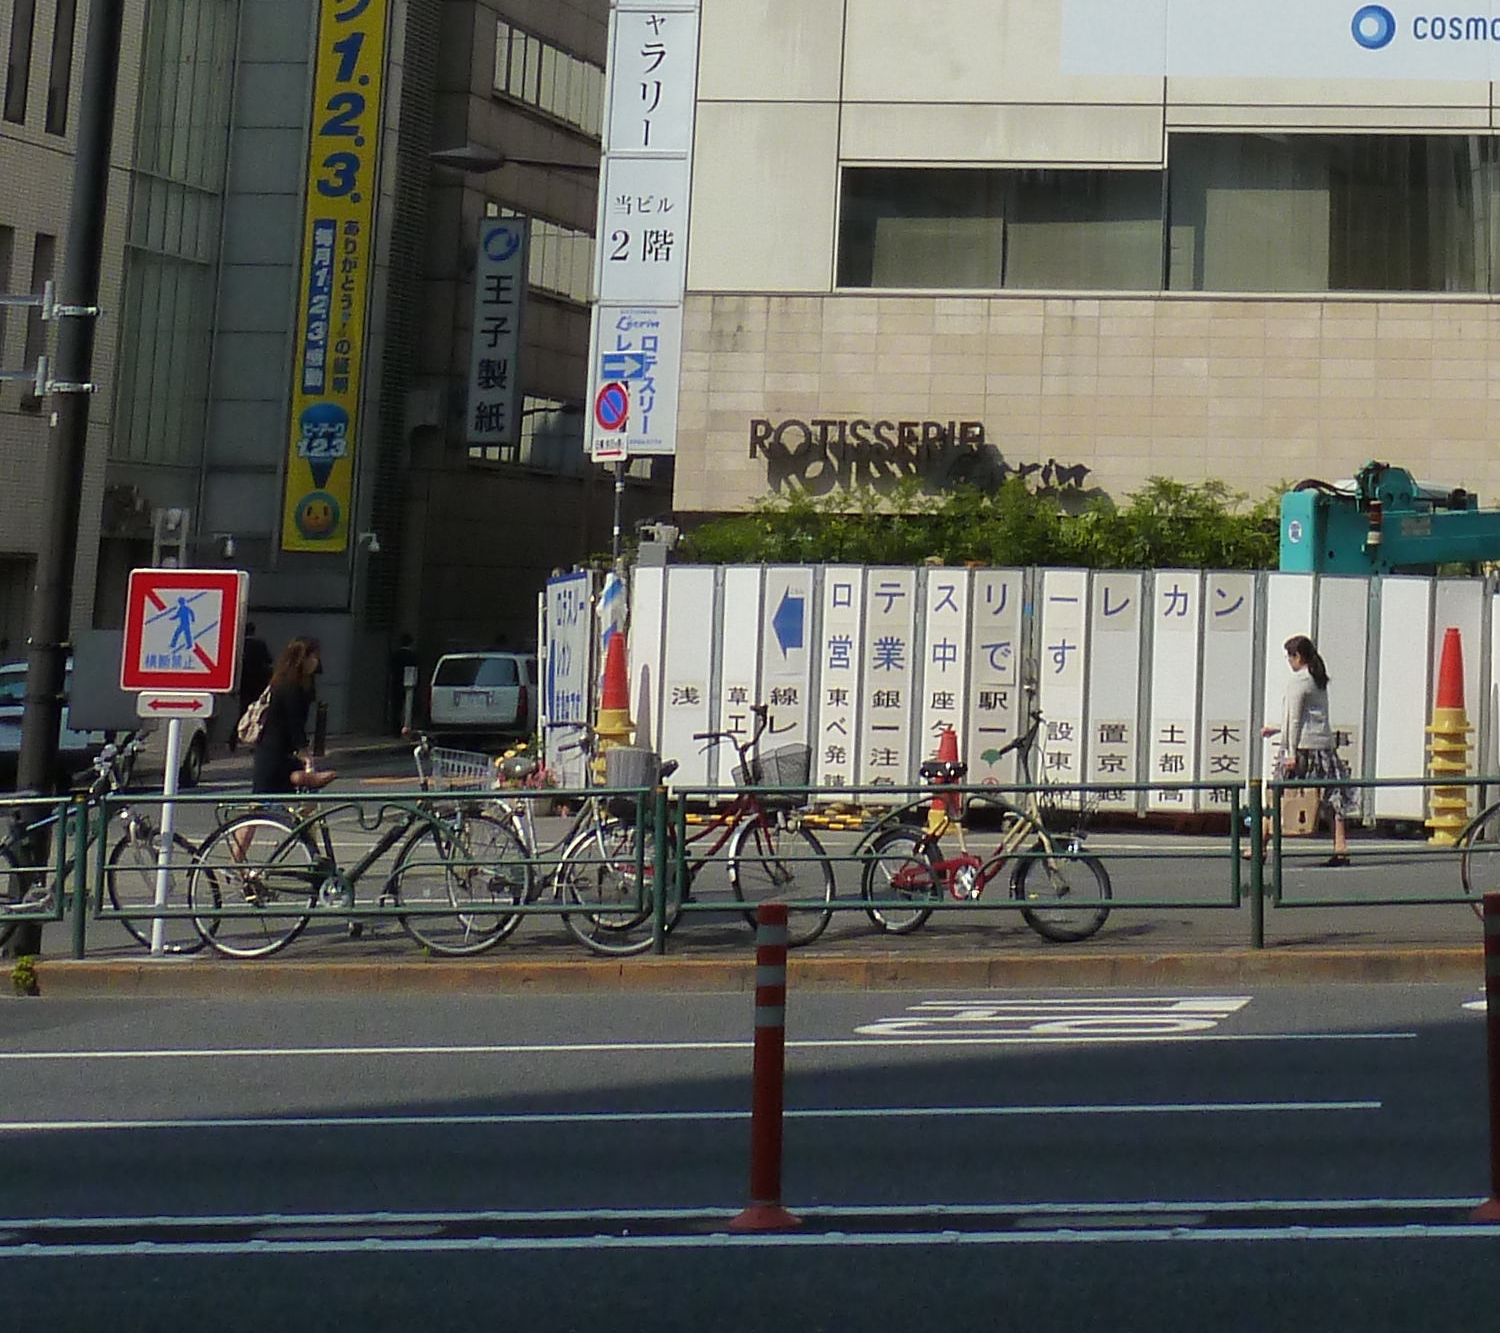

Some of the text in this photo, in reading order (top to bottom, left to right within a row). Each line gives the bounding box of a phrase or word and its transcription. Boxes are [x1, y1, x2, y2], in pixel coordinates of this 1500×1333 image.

[614, 194, 675, 216] 当ビル
[610, 229, 675, 263] 2階
[475, 273, 515, 433] 王子製紙
[638, 335, 659, 434] ロテスリー
[145, 653, 196, 670] 横断禁止
[828, 635, 1077, 672] 営業中です
[671, 686, 1008, 711] 浅草線東銀座駅
